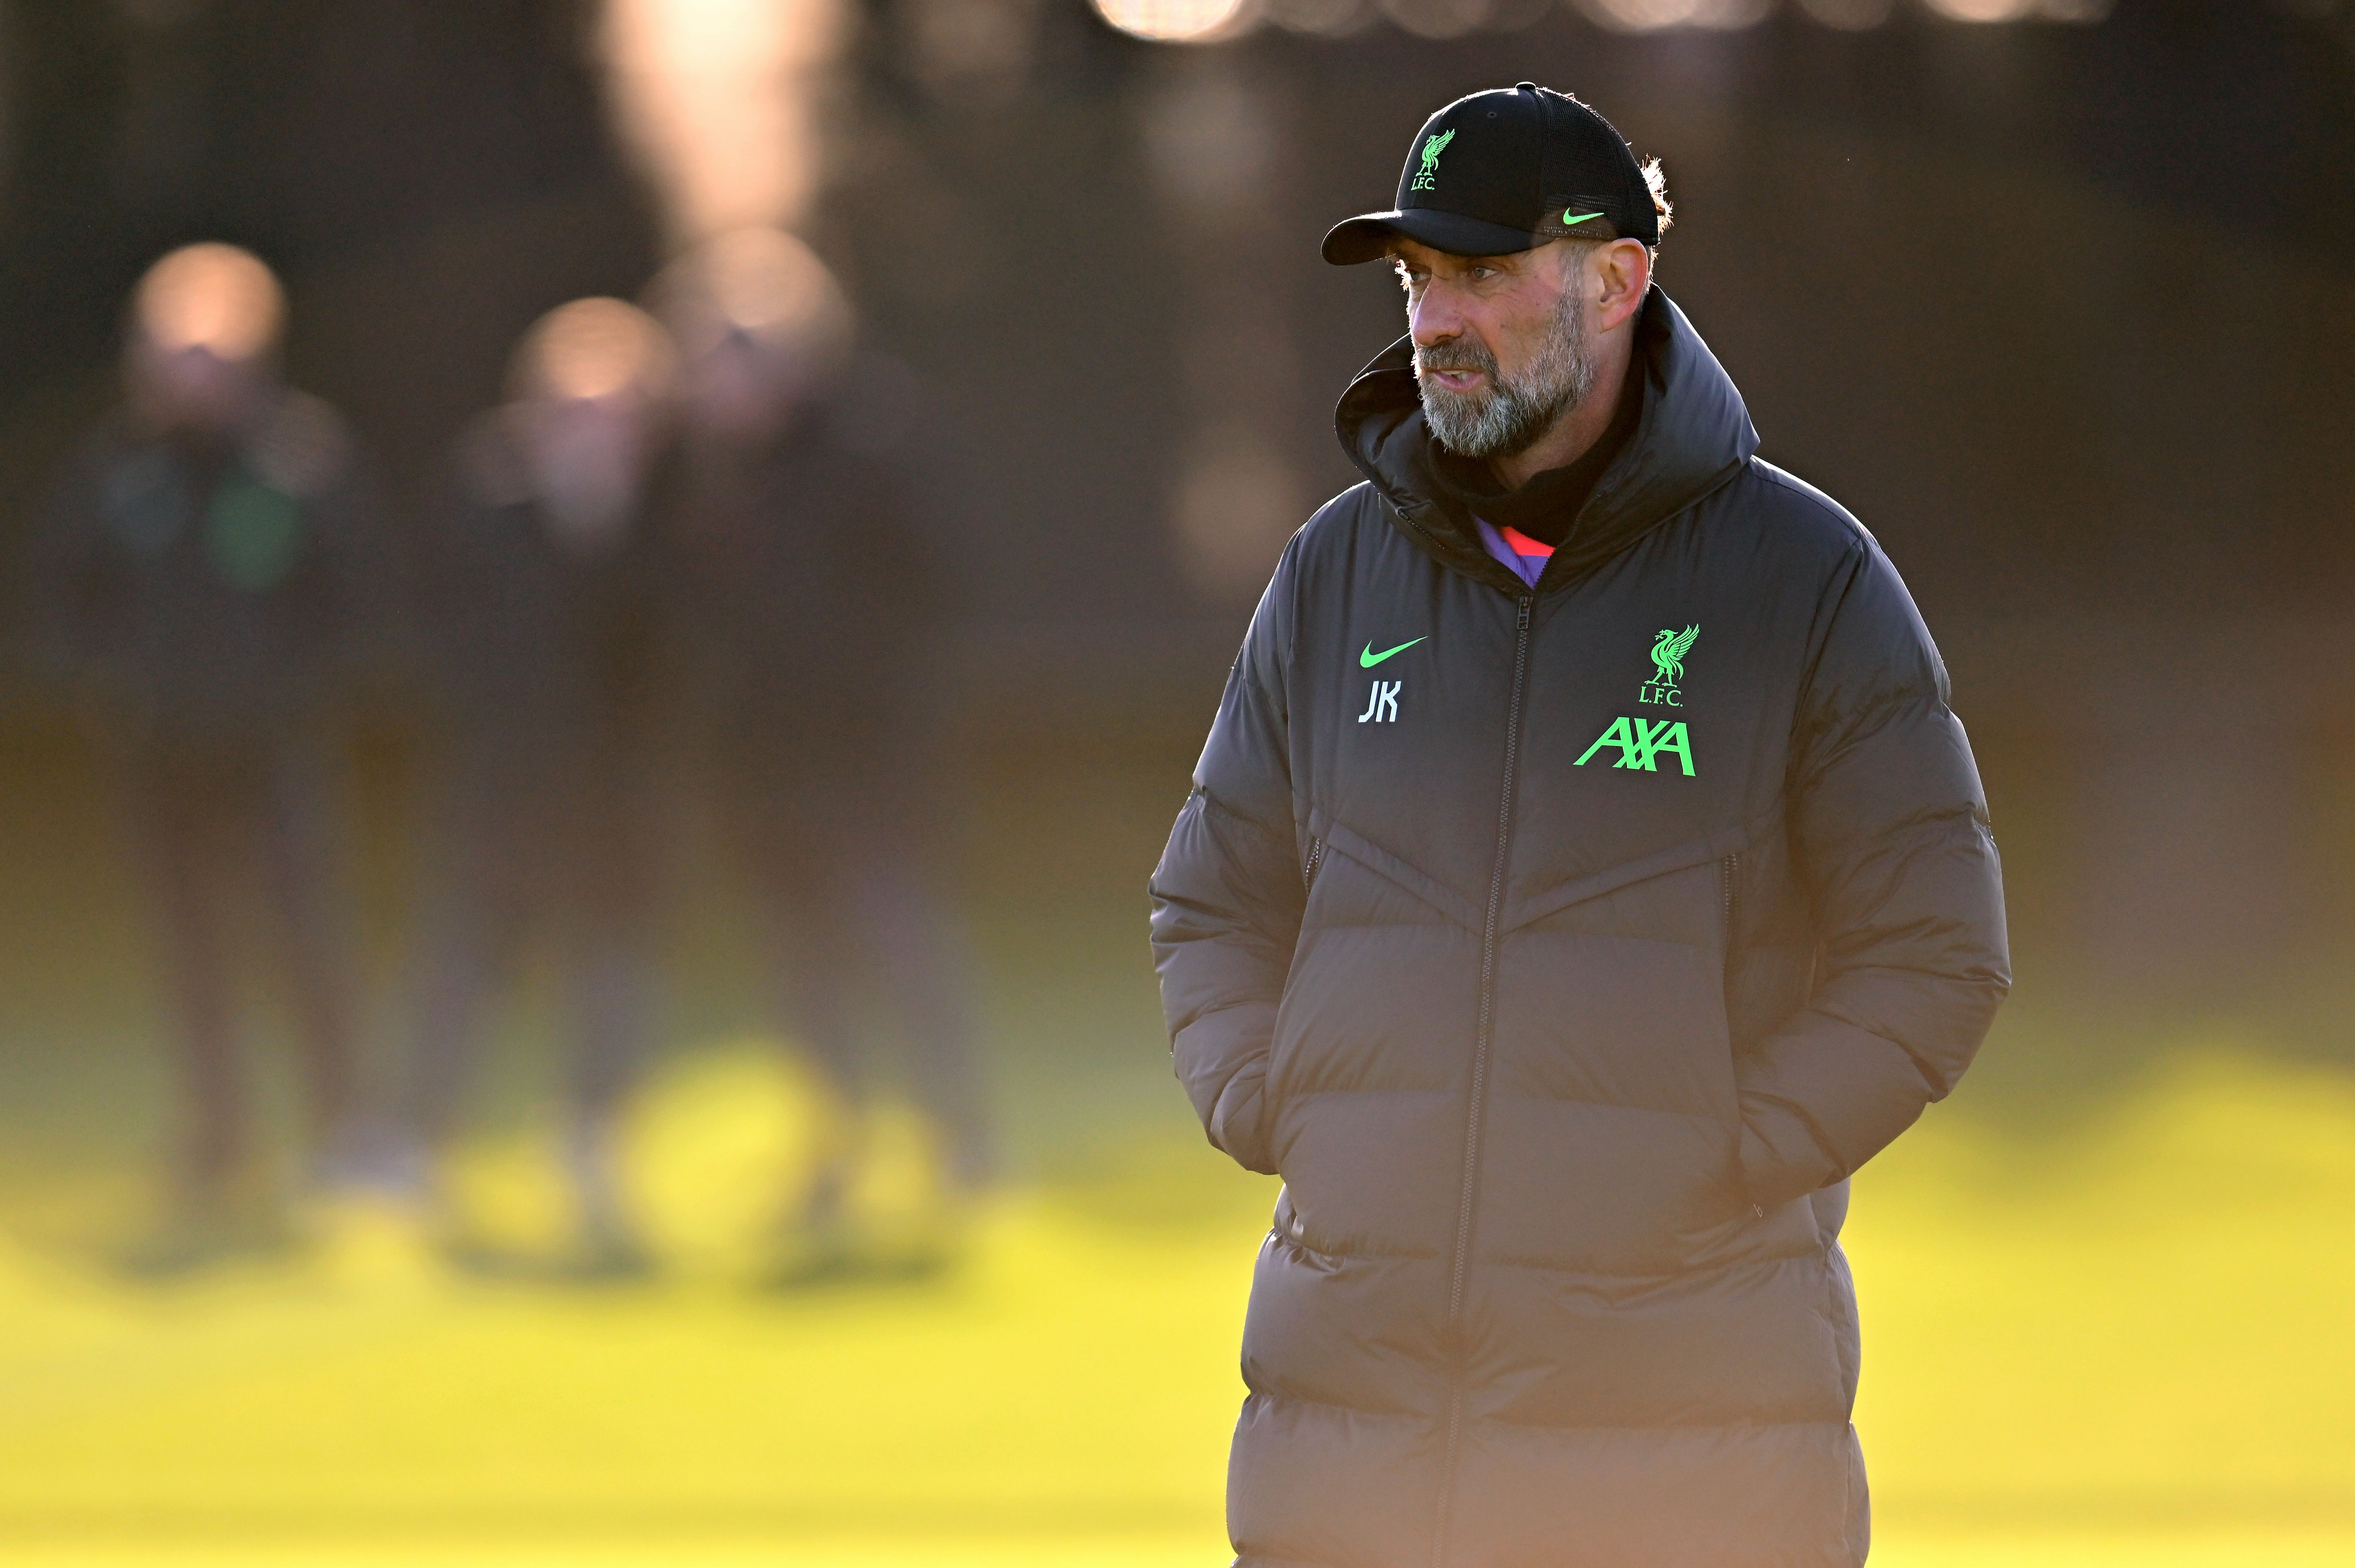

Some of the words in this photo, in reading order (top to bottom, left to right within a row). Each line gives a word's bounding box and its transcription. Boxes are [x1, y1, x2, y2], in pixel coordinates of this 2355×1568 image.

[1411, 177, 1435, 191] L.F.C.
[1358, 681, 1401, 723] JK
[1639, 686, 1684, 707] L.F.C.
[1573, 716, 1696, 776] AXA
